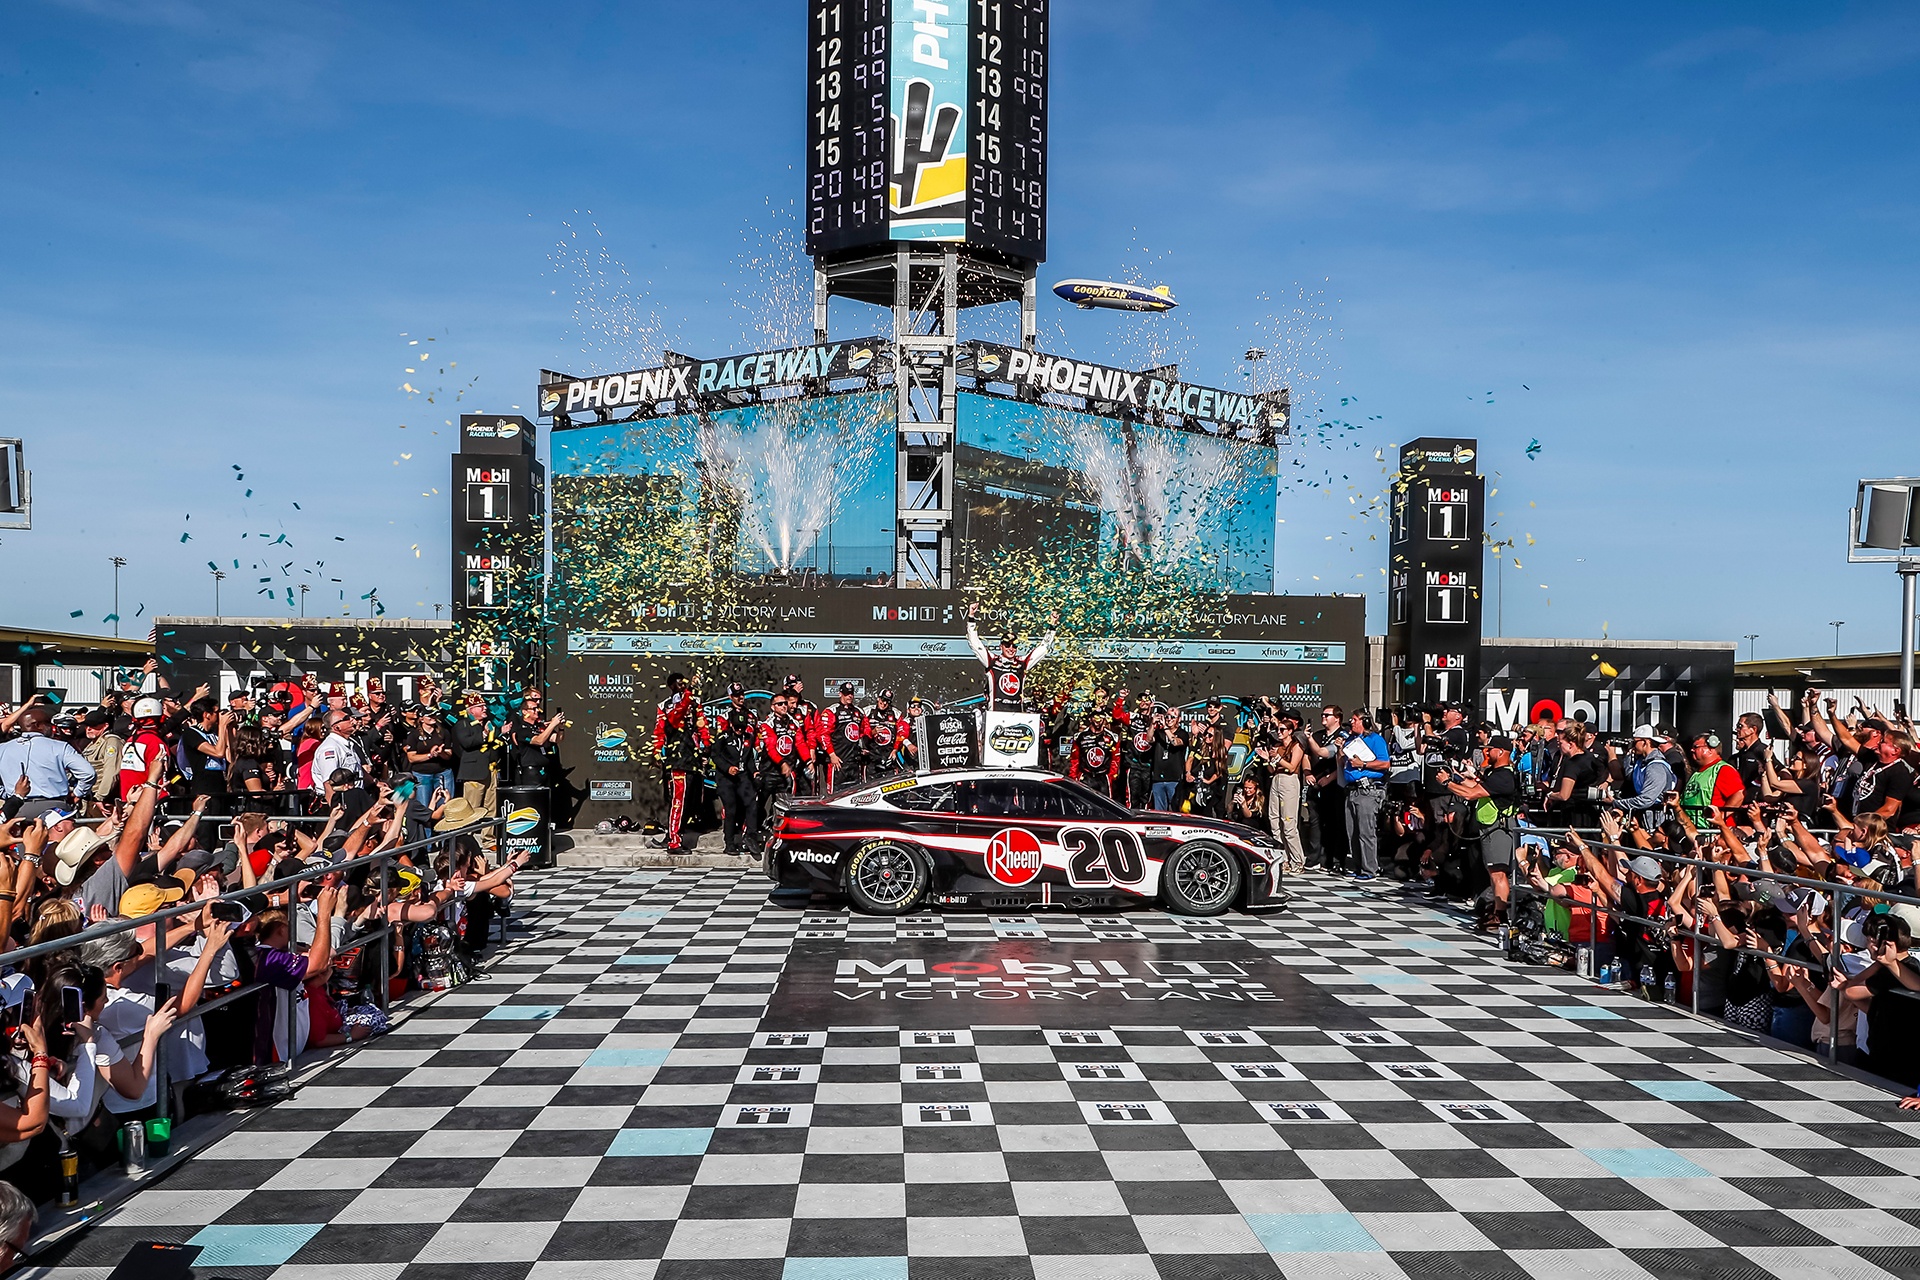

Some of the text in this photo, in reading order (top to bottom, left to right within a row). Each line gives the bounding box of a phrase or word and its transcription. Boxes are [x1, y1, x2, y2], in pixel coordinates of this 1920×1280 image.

[816, 4, 840, 36] 11
[977, 0, 1001, 32] 11
[1023, 15, 1043, 45] 11
[816, 25, 886, 69] 12 10
[977, 31, 1043, 79] 12 10
[816, 59, 885, 102] 13 99
[976, 64, 1043, 110] 13 99
[816, 92, 885, 135] 14 5
[976, 98, 1042, 144] 14 5
[815, 126, 885, 168] 15 77
[976, 132, 1042, 176] 15 77
[812, 160, 885, 201] 20 48
[973, 164, 1042, 209] 20 48
[811, 194, 884, 235] 21 47
[972, 197, 1041, 240] 21 47
[1073, 285, 1128, 299] GOODYEAR
[565, 344, 842, 411] PHOENIX RACEWAY
[1007, 350, 1264, 426] PHOENIX RACEWAY
[466, 467, 510, 483] Mobil
[479, 486, 494, 519] 1
[1428, 488, 1468, 502] Mobil
[1439, 506, 1453, 537] 1
[466, 555, 510, 569] Mobil
[479, 573, 493, 605] 1
[1426, 571, 1467, 586] Mobil
[780, 607, 816, 618] LANE
[872, 606, 917, 621] Mobil
[1437, 589, 1451, 620] 1
[1253, 614, 1287, 626] LANE
[788, 640, 818, 651] xfinity
[1261, 648, 1288, 658] xfinity
[1424, 653, 1465, 668] Mobil
[588, 674, 621, 685] Mobil
[1436, 672, 1449, 702] 1
[940, 720, 963, 730] BUSCH
[1487, 688, 1622, 733] Mobil
[937, 732, 968, 746] Coca-Cola
[937, 746, 969, 755] GEICO
[994, 739, 1030, 752] 500
[940, 755, 968, 767] xfinity
[500, 837, 538, 846] HOENIX
[1181, 829, 1229, 838] GOODYEAR
[789, 849, 841, 864] yahoo!
[850, 840, 892, 876] GOODYEAR
[992, 830, 1040, 877] Rheem
[1061, 828, 1146, 884] 20
[895, 887, 919, 909] EAGLE
[835, 959, 1211, 976] Mobil 1
[833, 989, 1284, 1002] VICTORY LANE
